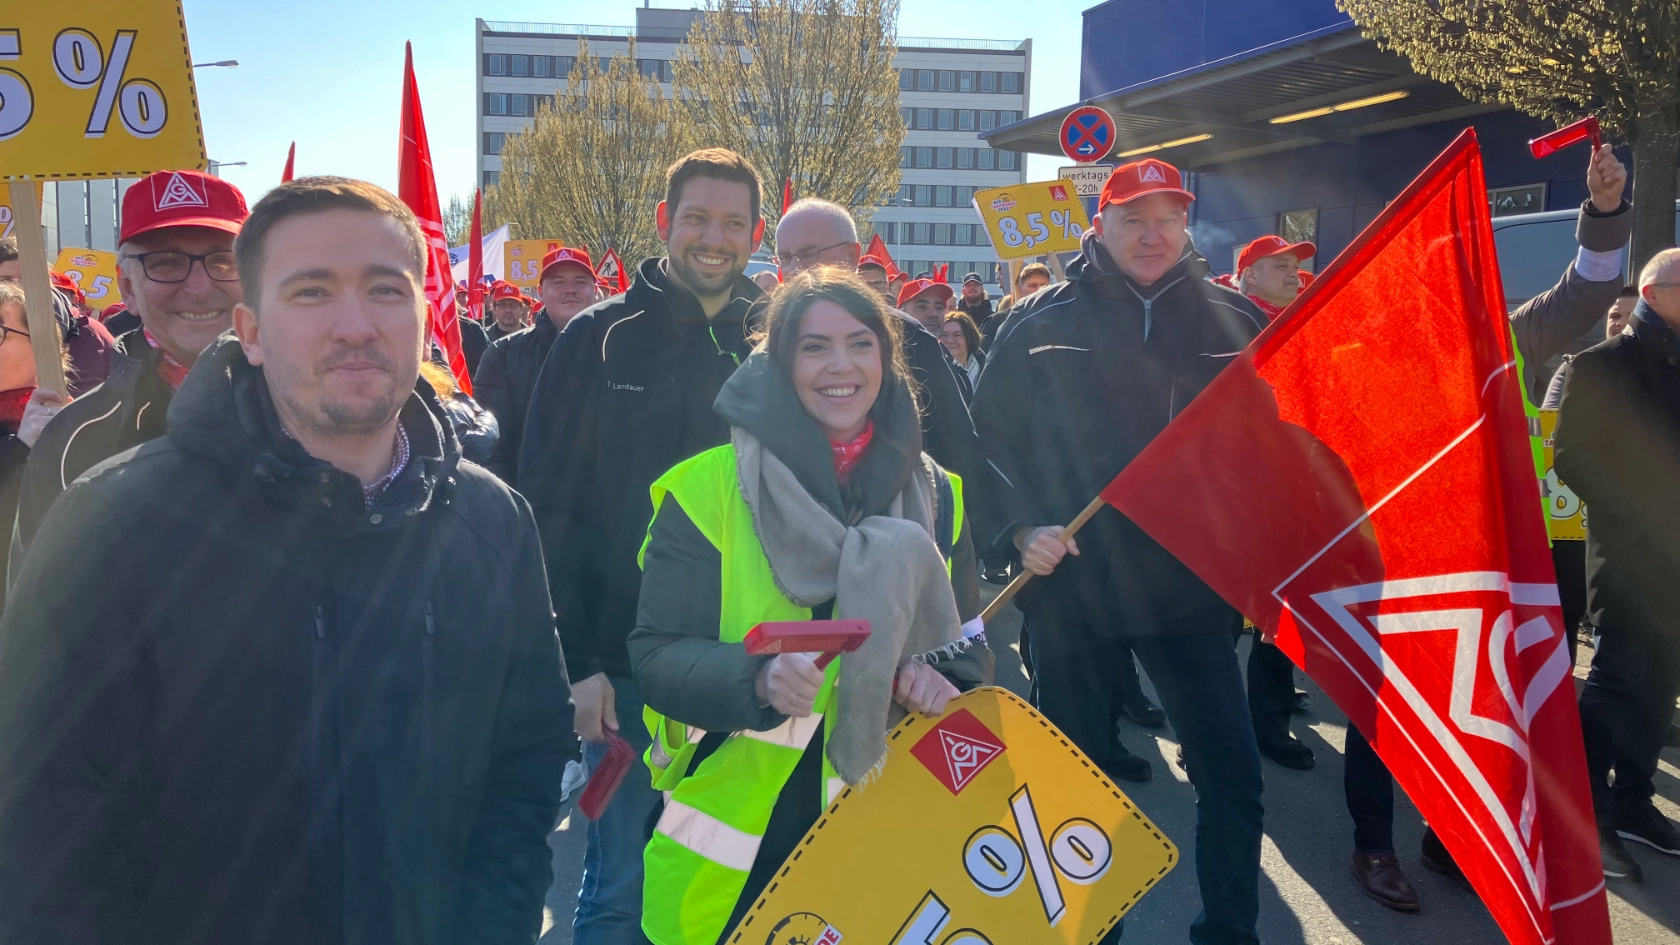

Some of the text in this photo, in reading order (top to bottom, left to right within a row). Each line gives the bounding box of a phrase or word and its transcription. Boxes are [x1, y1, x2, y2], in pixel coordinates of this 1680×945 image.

[1062, 171, 1109, 182] werktags
[511, 259, 539, 282] 8,5
[612, 382, 645, 392] Landauer
